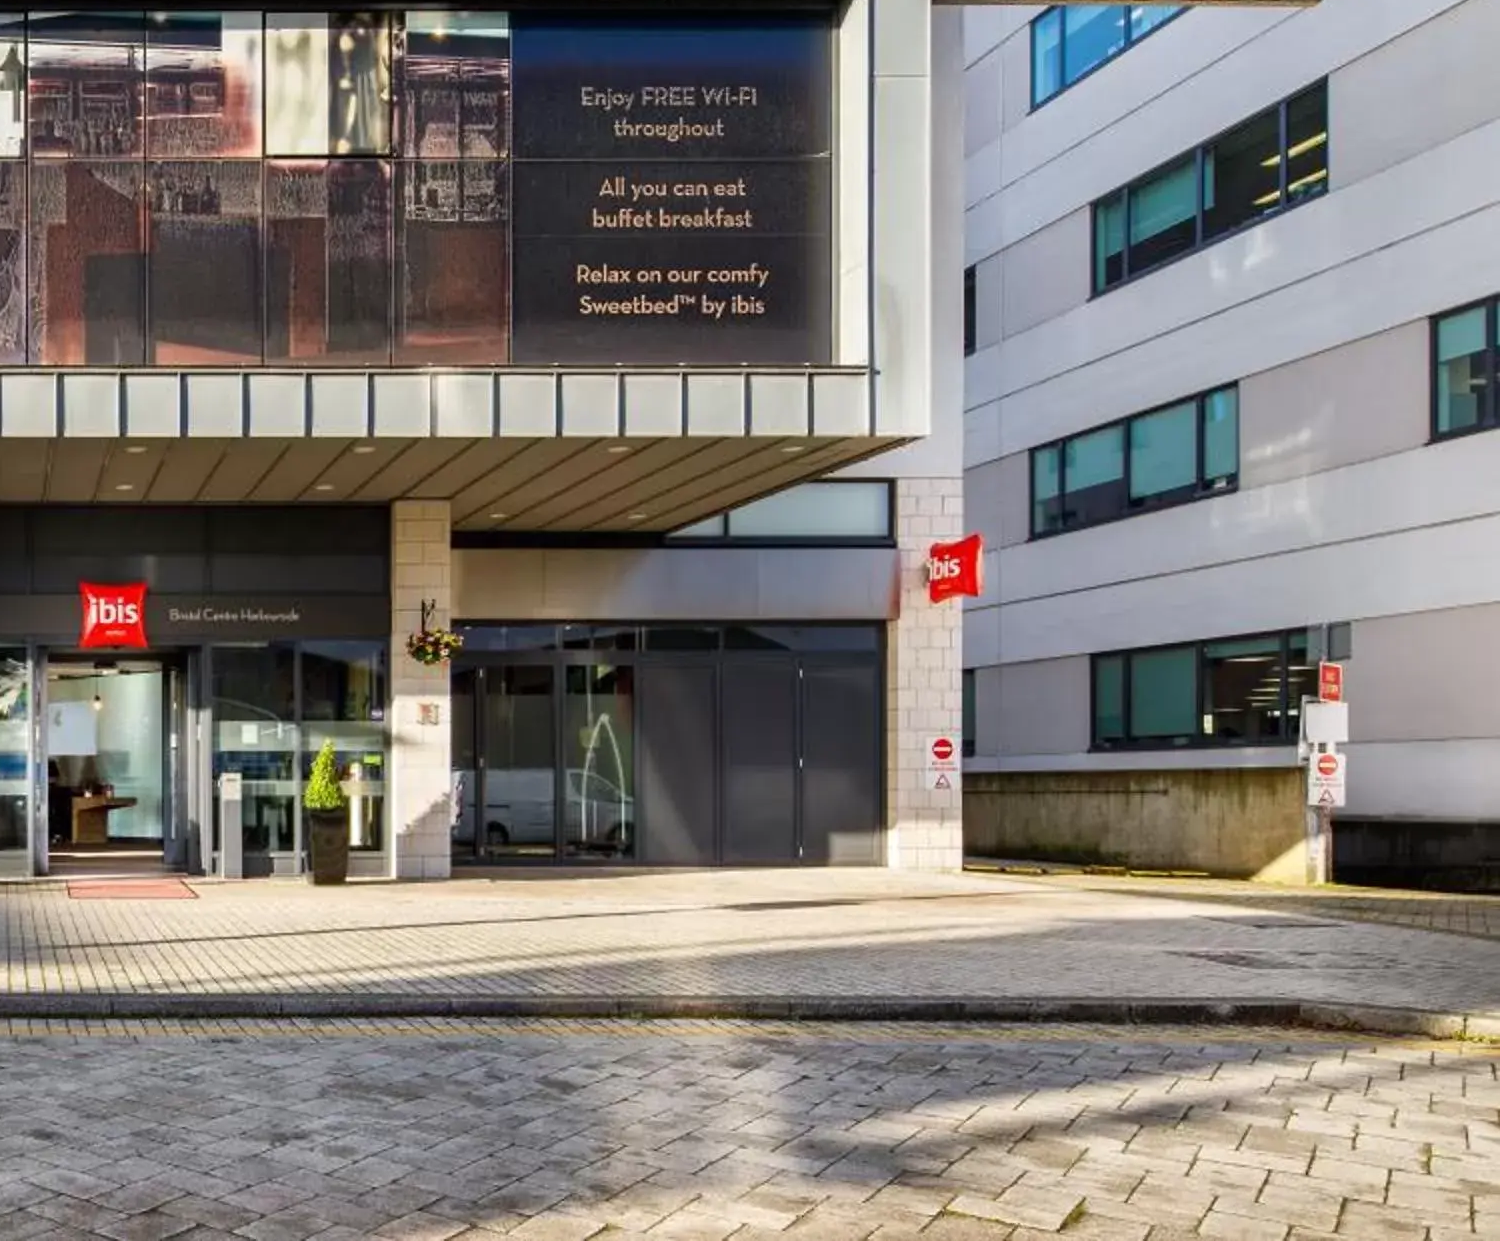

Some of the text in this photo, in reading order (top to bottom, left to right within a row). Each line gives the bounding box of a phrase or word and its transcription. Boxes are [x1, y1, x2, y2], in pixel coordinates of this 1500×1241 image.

[581, 86, 635, 110] Enjoy
[641, 86, 695, 106] FREE
[613, 117, 725, 142] throughout
[599, 177, 746, 201] All you can eat
[592, 208, 753, 228] buffet breakfast
[576, 263, 769, 287] Relax on our comfy
[702, 295, 726, 319] by
[731, 295, 765, 314] ibis
[926, 554, 961, 580] ibis
[89, 596, 140, 625] ibis
